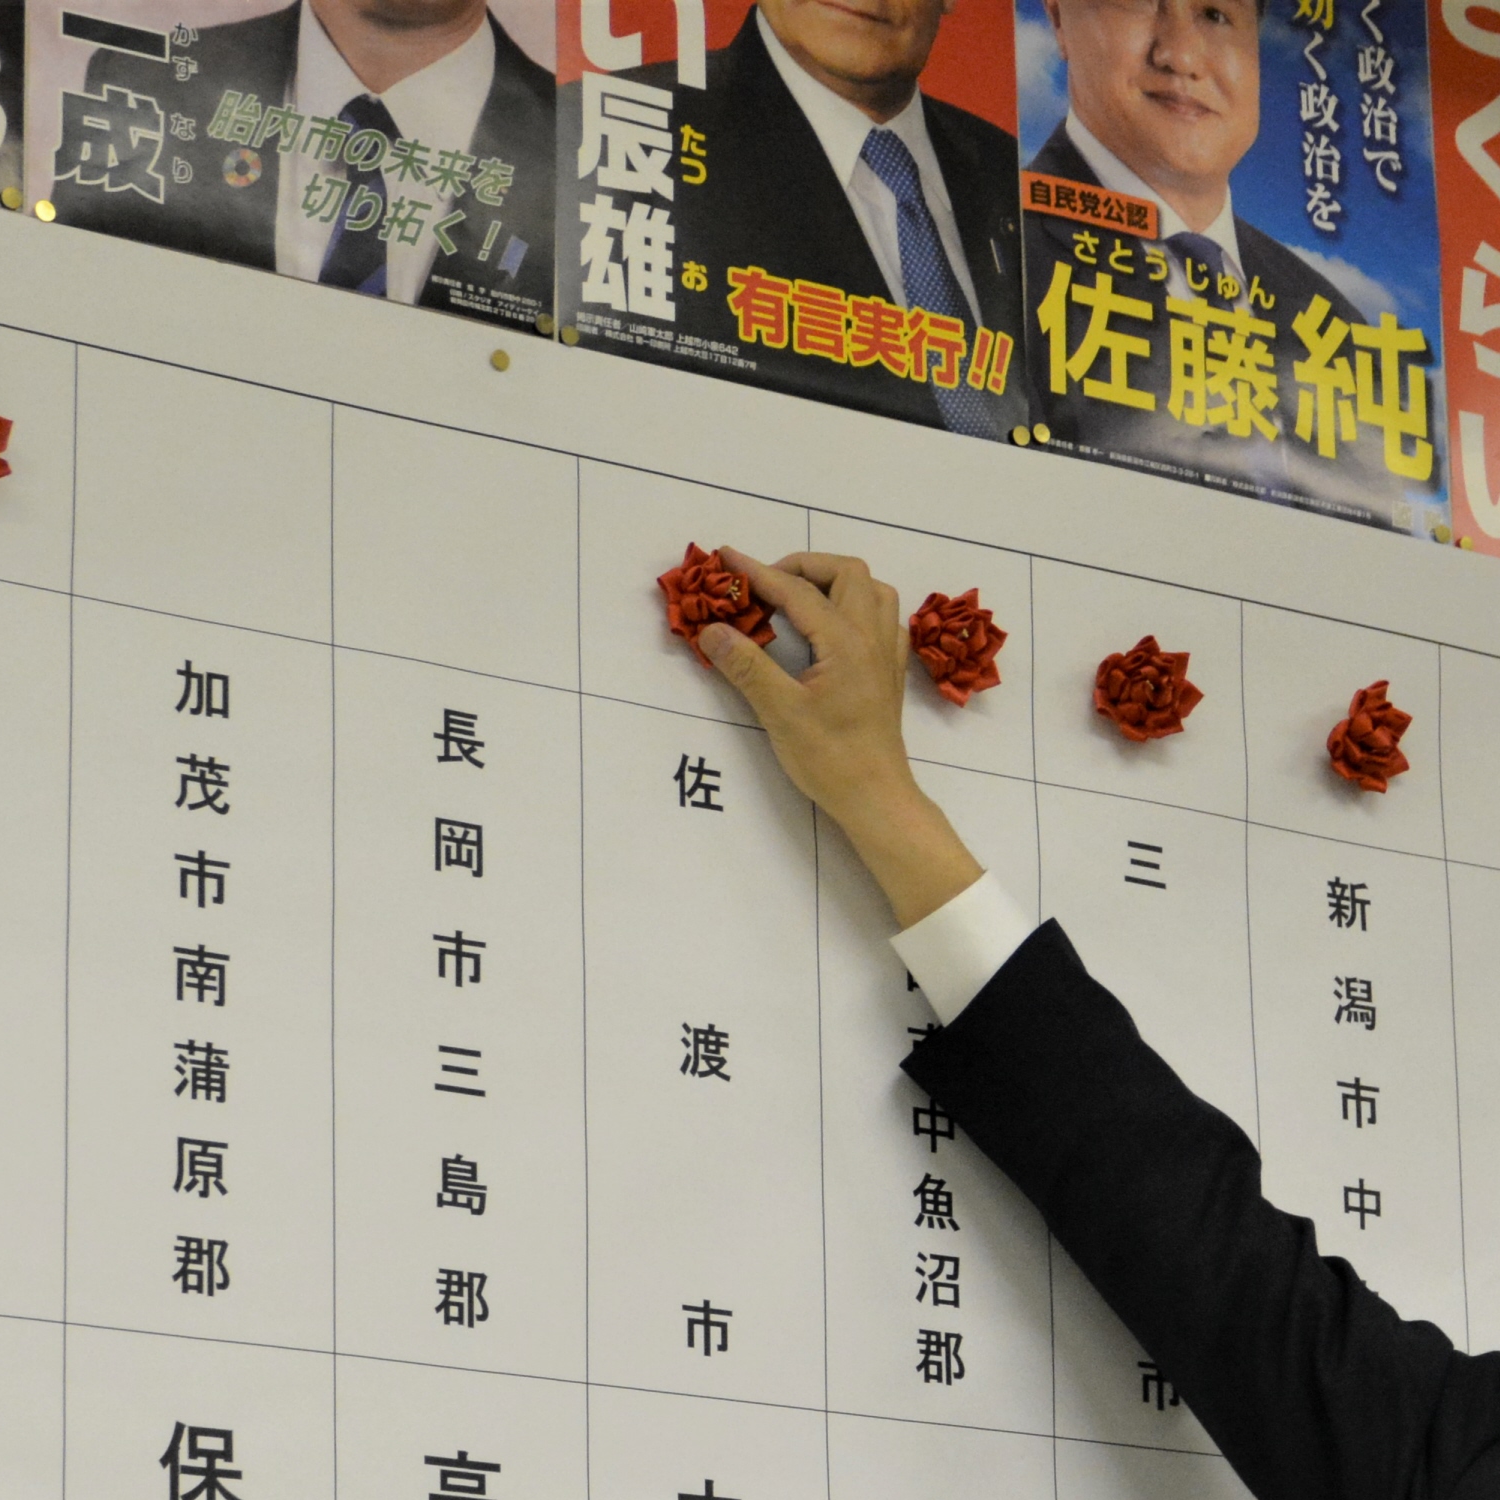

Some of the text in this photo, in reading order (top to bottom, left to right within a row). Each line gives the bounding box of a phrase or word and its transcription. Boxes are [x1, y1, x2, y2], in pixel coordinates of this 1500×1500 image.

[207, 90, 514, 207] 胎内市の未来を
[301, 172, 502, 262] 切り拓く！
[1029, 180, 1149, 232] 自民党公認
[173, 660, 230, 1296] 加茂市南蒲原郡
[433, 709, 489, 1328] 長岡市三島郡
[673, 754, 732, 1356] 佐渡市
[1327, 877, 1382, 1299] 新潟市中
